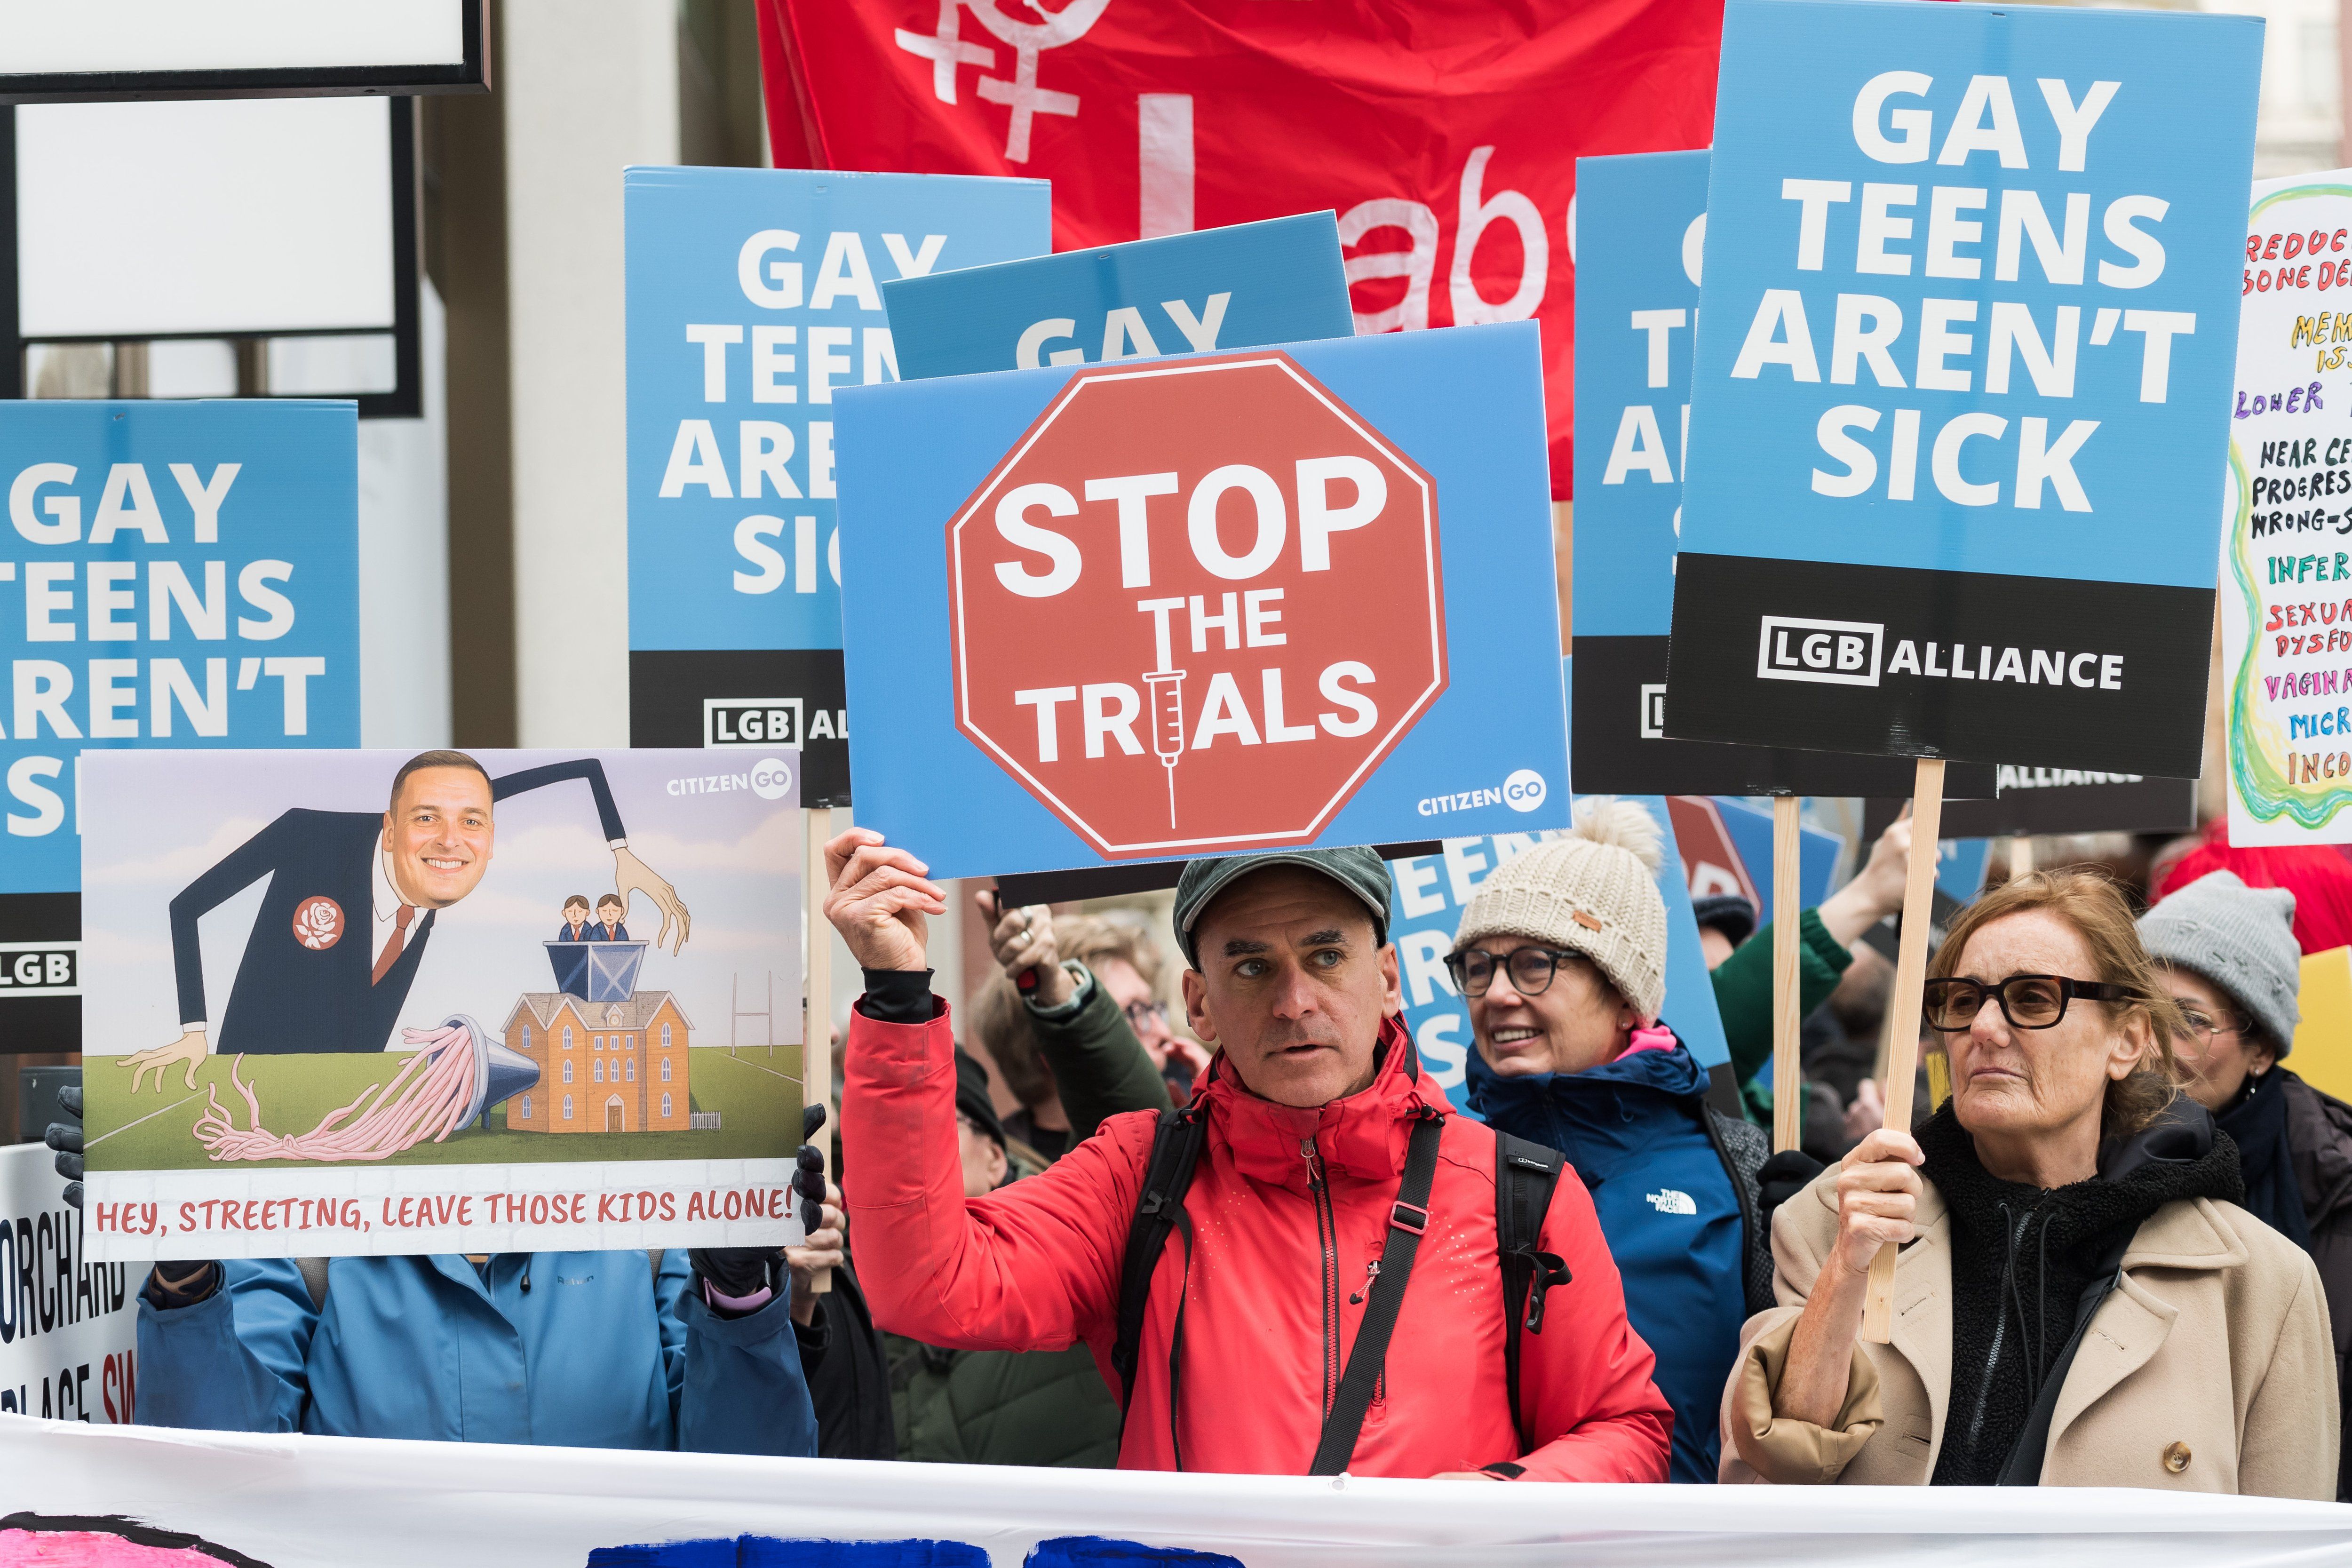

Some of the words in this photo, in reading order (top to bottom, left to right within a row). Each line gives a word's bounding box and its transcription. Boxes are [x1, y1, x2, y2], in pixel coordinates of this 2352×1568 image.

[1852, 71, 2122, 172] GAY
[738, 229, 947, 310] GAY
[1781, 179, 2170, 289] TEENS
[2318, 259, 2352, 291] DE
[1016, 292, 1232, 370] GAY
[1731, 289, 2196, 404] AREN'T
[2317, 346, 2352, 373] IS
[2234, 382, 2323, 419] LOWER
[1812, 405, 2102, 513] SICK
[2260, 438, 2317, 468] NEAR
[9, 462, 243, 545] GAY
[994, 456, 1387, 597] STOP
[734, 515, 841, 594] SI
[2268, 552, 2351, 585] INFER
[0, 559, 295, 642] EENS
[1137, 588, 1287, 673] THE
[0, 657, 325, 740] REN'T
[1775, 631, 1864, 670] LGB
[1887, 640, 2124, 691] ALLIANCE
[718, 710, 790, 740] LGB
[1015, 661, 1378, 763] TRIALS
[2288, 707, 2351, 740] MICR
[2288, 751, 2351, 785] INCO
[97, 1202, 167, 1237] HEY,
[179, 1198, 370, 1232] STREETING,
[383, 1194, 473, 1227] LEAVE
[484, 1193, 586, 1225] THOSE
[598, 1191, 675, 1223] KIDS
[687, 1185, 792, 1222] ALONE!
